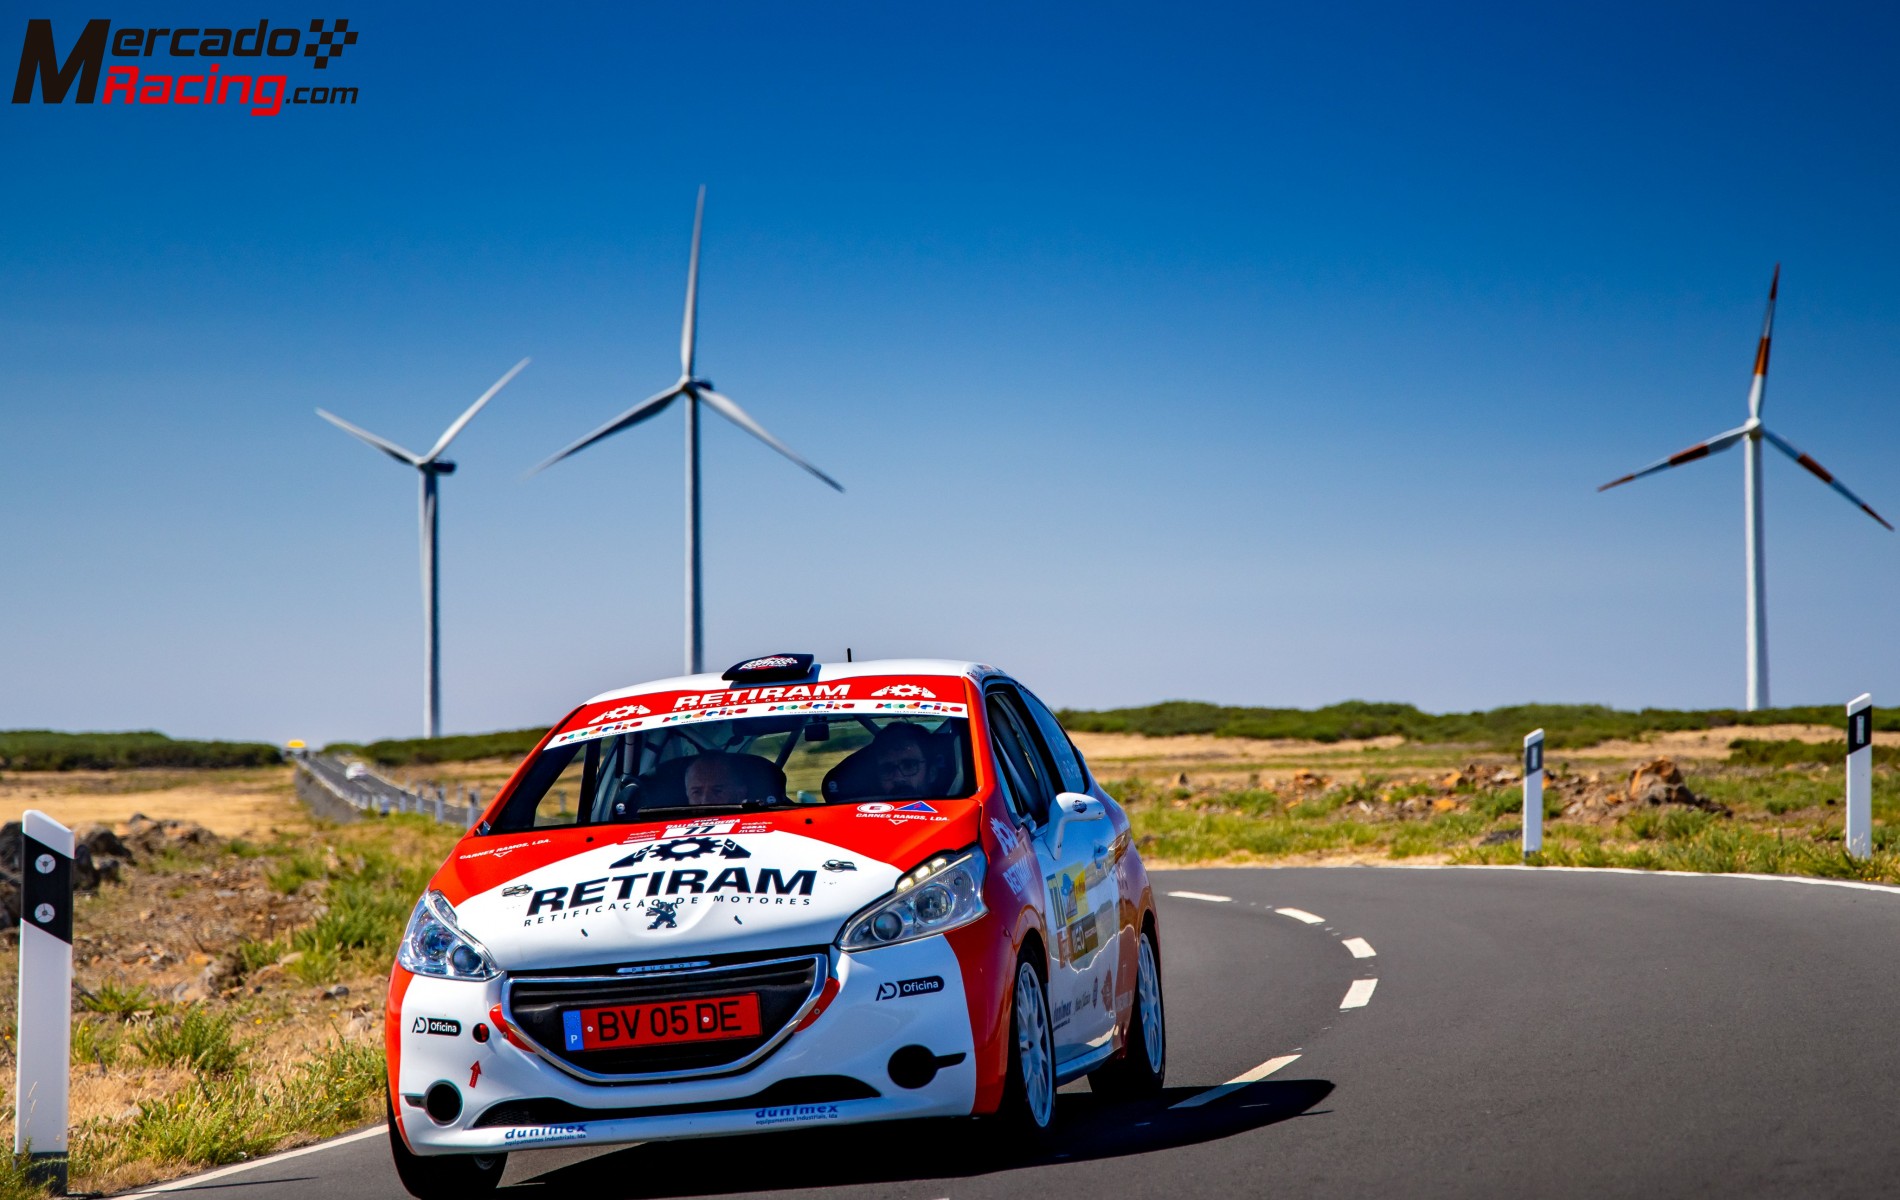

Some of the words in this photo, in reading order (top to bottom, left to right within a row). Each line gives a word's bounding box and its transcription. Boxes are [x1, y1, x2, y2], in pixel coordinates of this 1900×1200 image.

[673, 684, 851, 709] RETIRAM
[526, 867, 818, 916] RETIRAM
[523, 898, 660, 927] RETIFICAÇÃO
[676, 896, 699, 905] DE
[713, 895, 810, 906] MOTORES
[632, 962, 693, 974] PEUGEOT
[903, 980, 939, 993] Oficina
[430, 1021, 457, 1033] Oficina
[597, 1009, 640, 1042] BV
[650, 1005, 689, 1037] 05
[696, 1000, 742, 1034] DE
[570, 1034, 578, 1044] P
[755, 1105, 838, 1119] dunimex
[505, 1123, 588, 1140] dunimex
